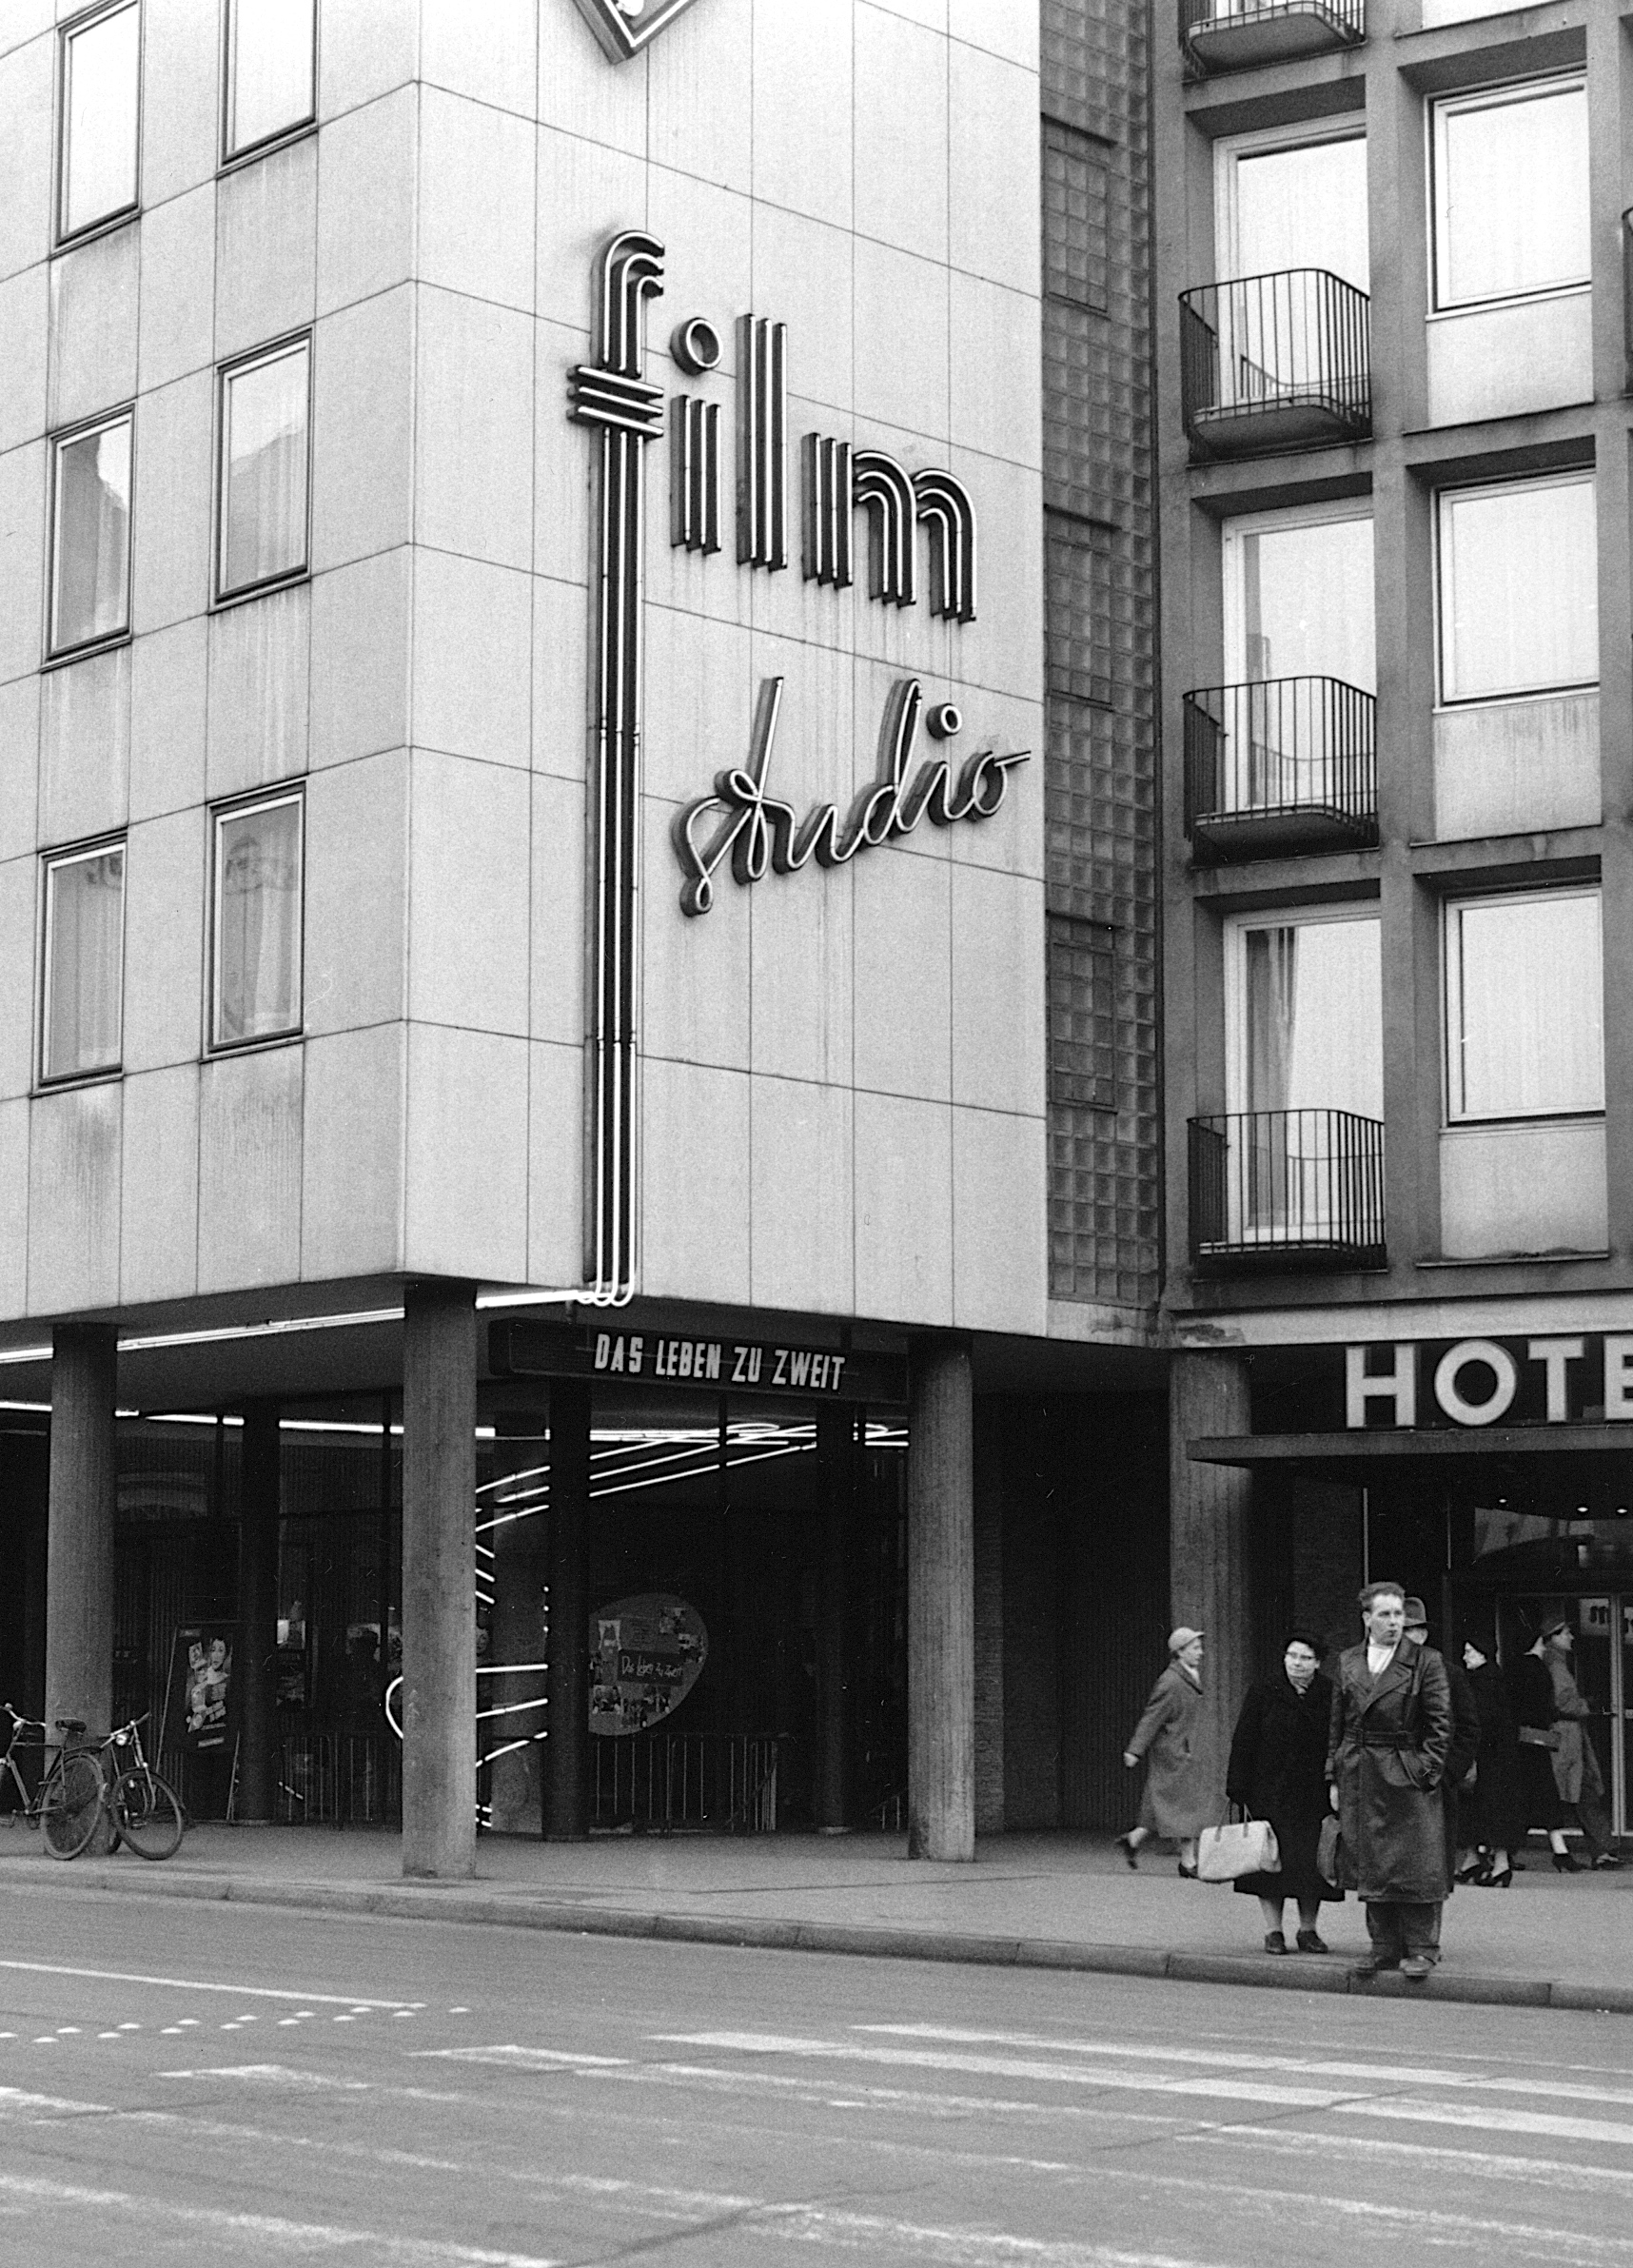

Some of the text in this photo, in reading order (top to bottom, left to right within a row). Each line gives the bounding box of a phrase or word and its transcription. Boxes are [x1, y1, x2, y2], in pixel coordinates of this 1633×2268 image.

[672, 677, 1032, 917] studio
[594, 1333, 846, 1390] DAS LEBEN ZU ZWEIT
